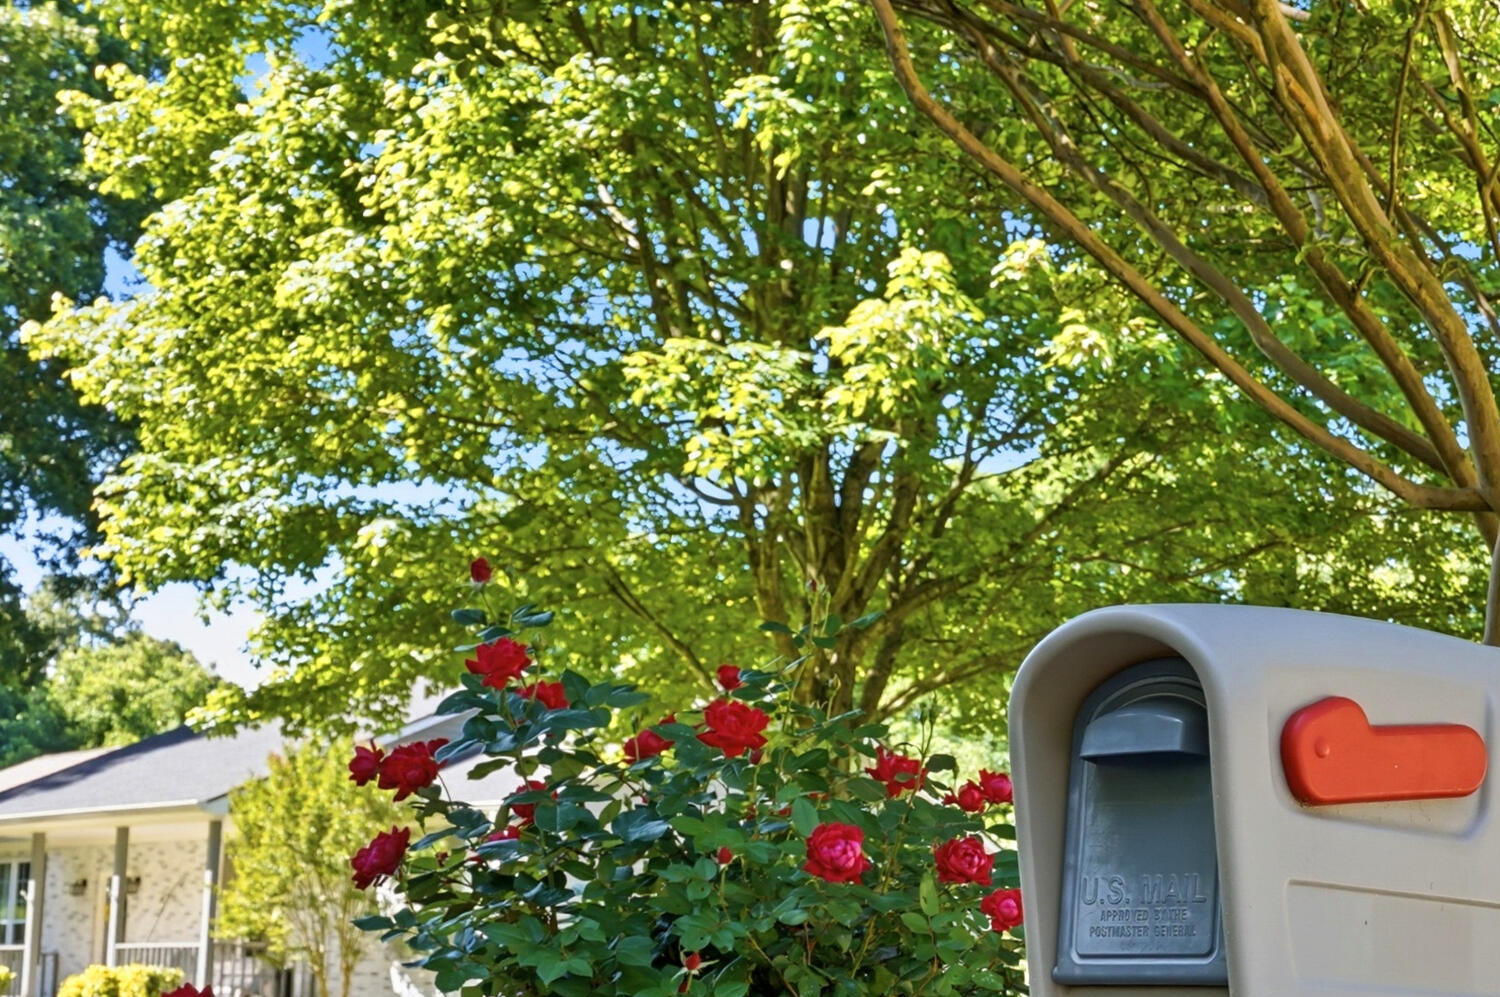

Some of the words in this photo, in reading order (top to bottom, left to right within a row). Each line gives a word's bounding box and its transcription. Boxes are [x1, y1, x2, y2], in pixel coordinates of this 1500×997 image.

[1082, 875, 1130, 906] U.S.
[1140, 873, 1208, 904] MAIL
[1100, 908, 1149, 922] APPROVED
[1154, 908, 1167, 921] BY
[1168, 907, 1188, 921] THE
[1089, 925, 1150, 938] POSTMASTER
[1154, 925, 1197, 937] GENERAL
